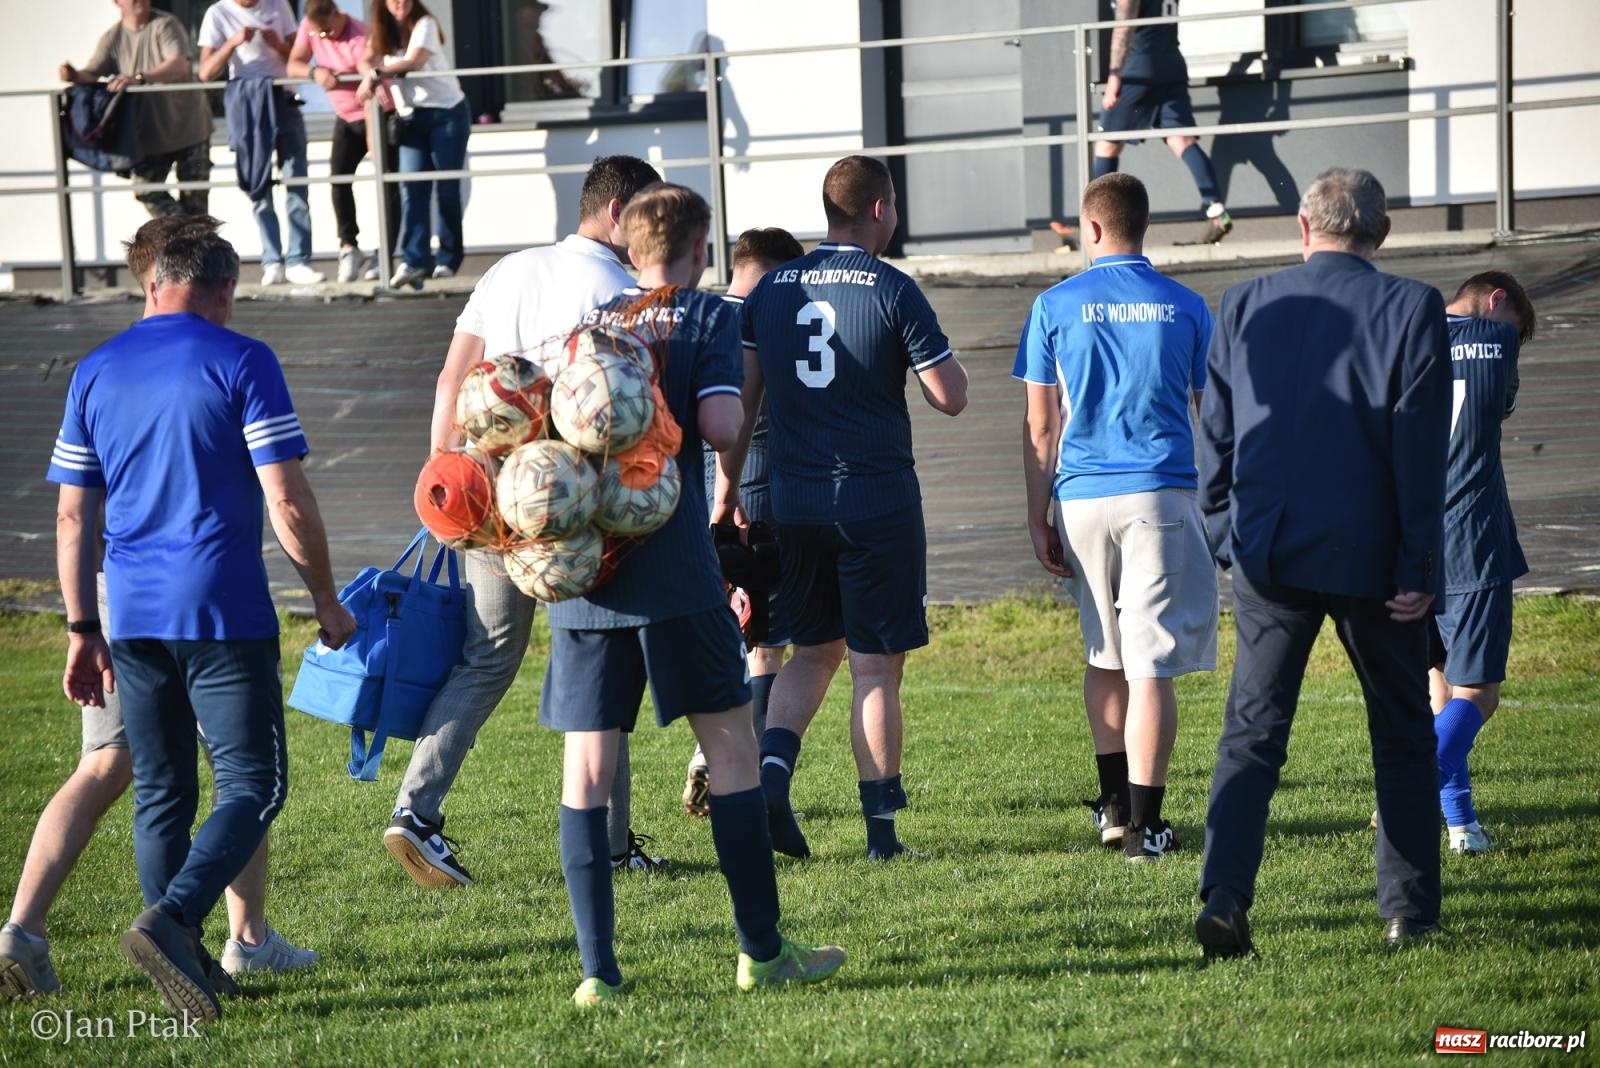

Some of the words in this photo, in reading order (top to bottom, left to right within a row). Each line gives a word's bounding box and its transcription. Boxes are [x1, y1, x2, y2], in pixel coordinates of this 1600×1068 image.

[773, 269, 799, 284] LKS
[800, 269, 877, 287] WOJNOWICE
[1081, 303, 1105, 323] LKS
[1107, 302, 1176, 323] WOJNOWICE
[795, 300, 836, 389] 3
[1450, 343, 1503, 361] OWICE
